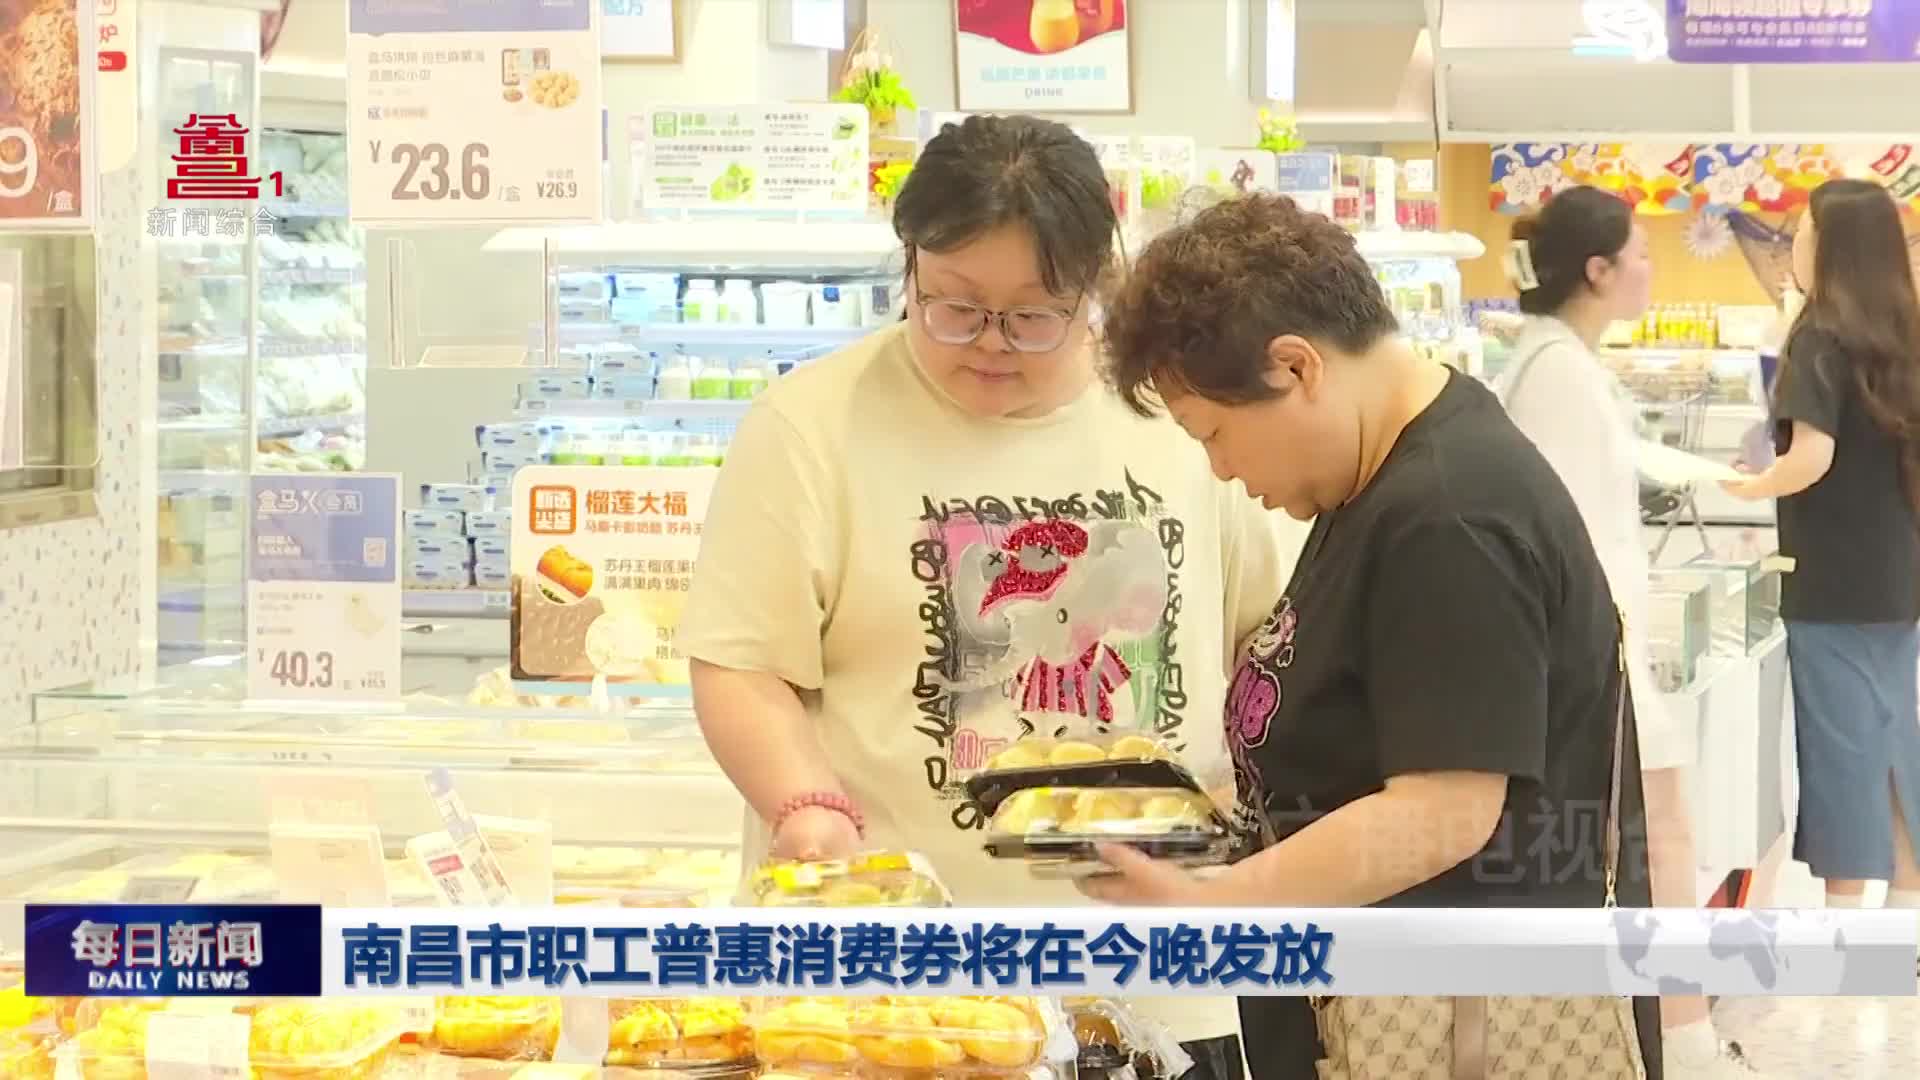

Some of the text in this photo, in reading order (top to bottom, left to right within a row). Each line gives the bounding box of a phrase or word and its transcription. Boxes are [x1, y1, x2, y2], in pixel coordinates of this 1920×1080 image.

[391, 142, 490, 200] 23.6
[537, 182, 577, 198] ¥26.9
[585, 489, 689, 516] 榴莲大福
[603, 558, 696, 574] 苏丹王榴莲果
[271, 650, 333, 688] 40.3
